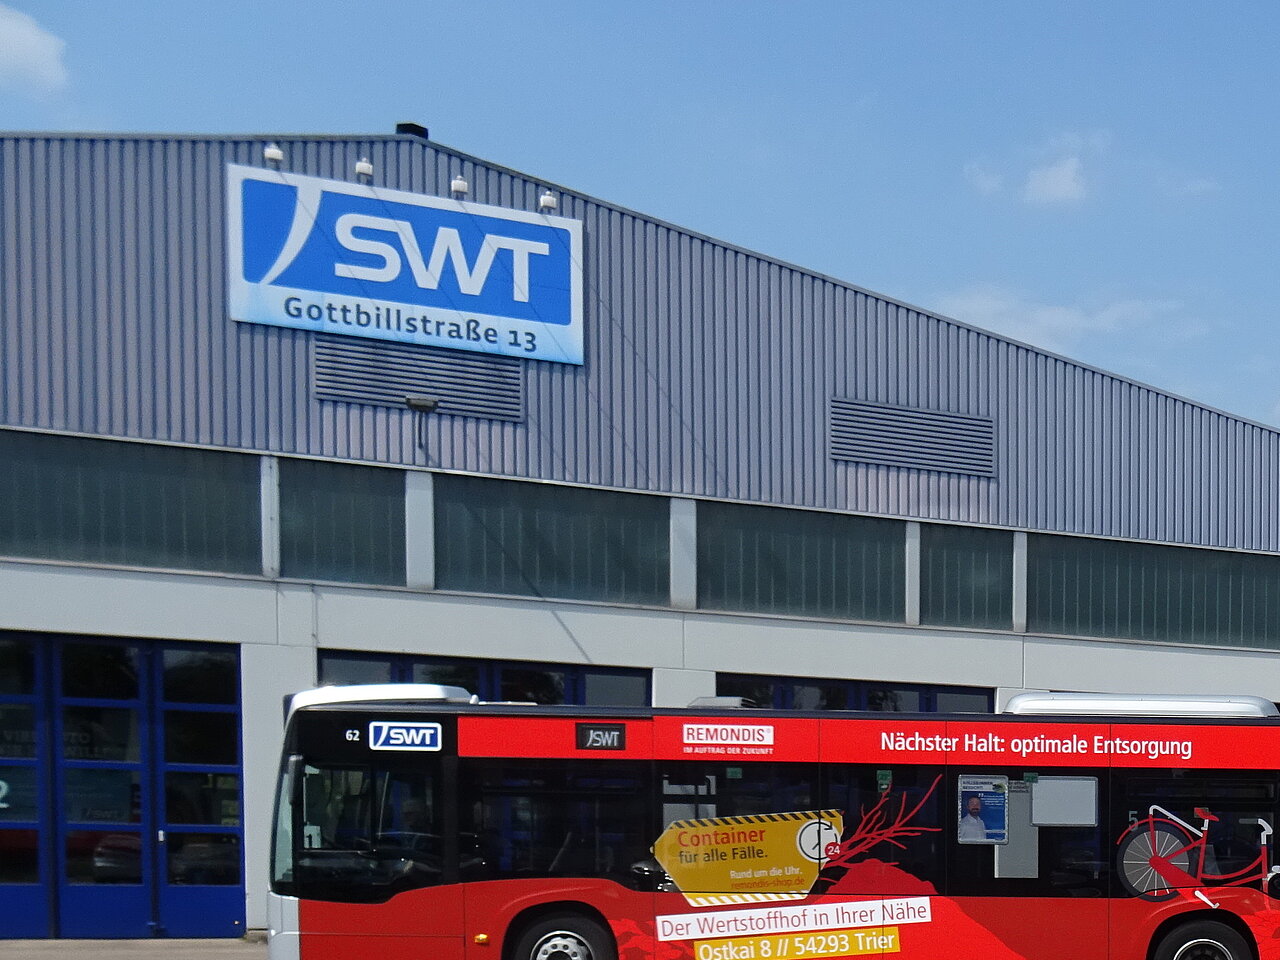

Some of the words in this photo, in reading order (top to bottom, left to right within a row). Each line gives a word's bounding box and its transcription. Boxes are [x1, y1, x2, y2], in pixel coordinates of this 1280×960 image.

[334, 213, 549, 303] SWT
[284, 296, 499, 343] Gottbillstraße
[508, 330, 538, 353] 13
[345, 730, 360, 741] 62
[389, 728, 435, 745] SWT
[881, 732, 958, 752] Nächster
[964, 733, 1005, 752] Halt:
[1010, 734, 1088, 757] optimale
[1093, 736, 1192, 759] Entsorgung
[678, 827, 766, 847] Container
[678, 850, 698, 864] für
[703, 848, 727, 862] alle
[732, 846, 768, 860] Fälle.
[827, 845, 840, 855] 24
[730, 869, 751, 879] Rund
[754, 870, 768, 878] um
[769, 867, 782, 876] die
[785, 866, 803, 875] Uhr.
[731, 877, 805, 890] remondis-shop.de
[661, 919, 692, 937] Der
[697, 907, 808, 934] Wertstoffhof
[813, 909, 829, 926] in
[836, 905, 876, 924] Ihrer
[882, 901, 927, 921] Nähe
[760, 941, 772, 958] 8
[794, 934, 850, 956] 54293
[854, 932, 895, 951] Trier
